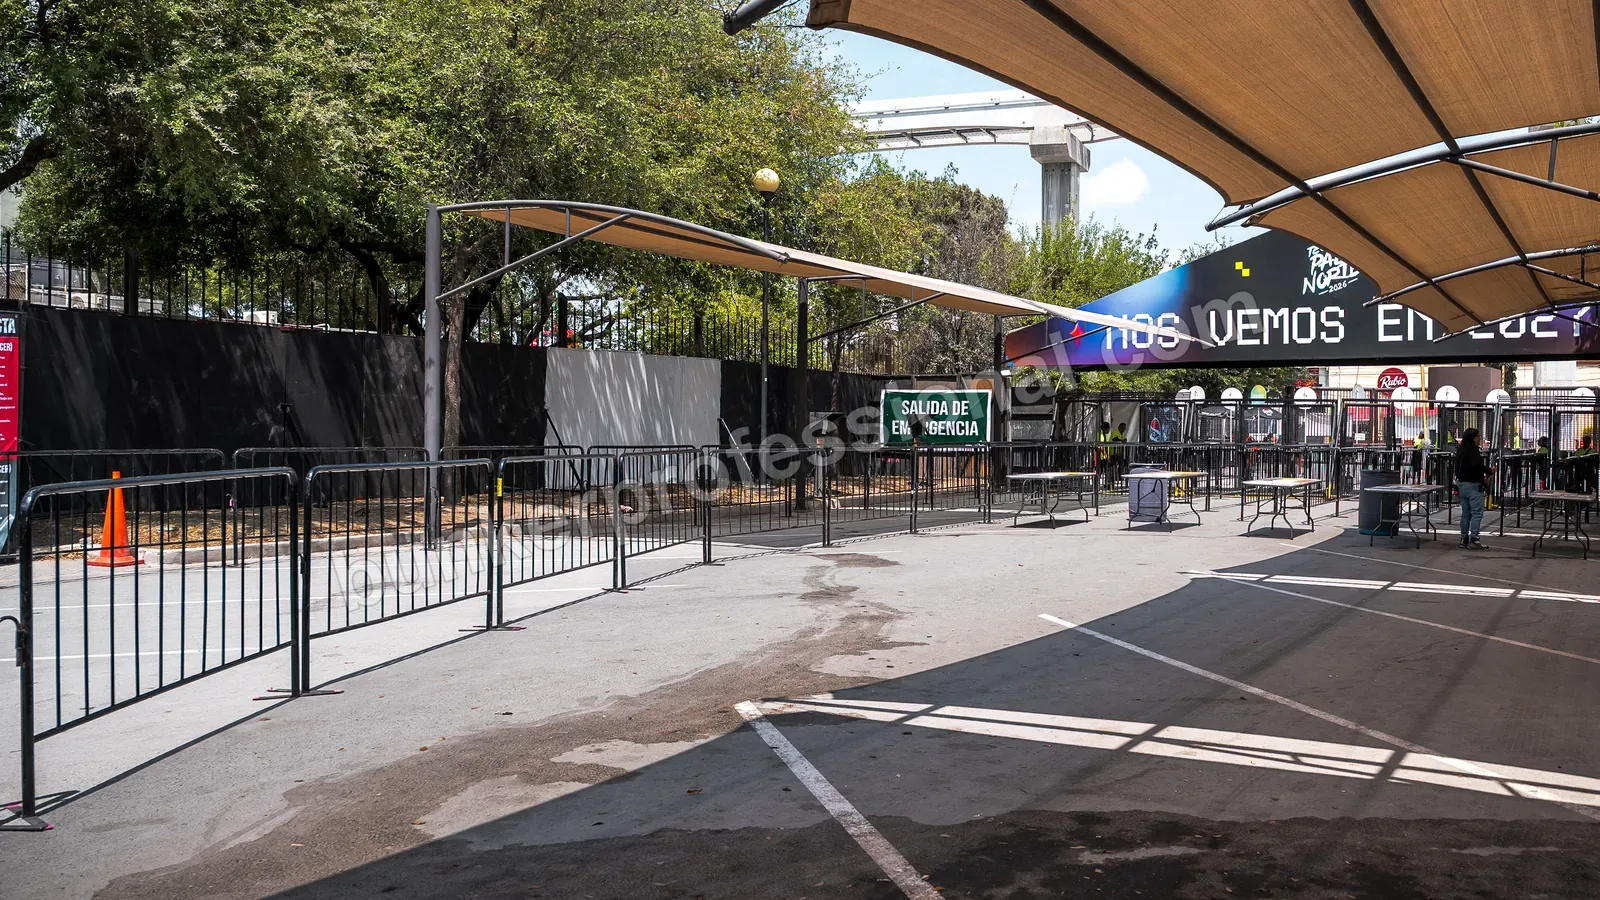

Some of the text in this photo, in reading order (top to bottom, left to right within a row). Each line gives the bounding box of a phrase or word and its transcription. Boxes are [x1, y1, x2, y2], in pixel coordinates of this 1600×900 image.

[1307, 245, 1324, 258] TE
[1328, 280, 1347, 293] 2026
[1106, 312, 1180, 350] NOS
[1209, 306, 1345, 346] VEMOS
[1378, 303, 1433, 341] EN
[1380, 375, 1406, 389] Rubio
[901, 400, 970, 416] SALIDA DE
[891, 420, 979, 436] EMGENCIA
